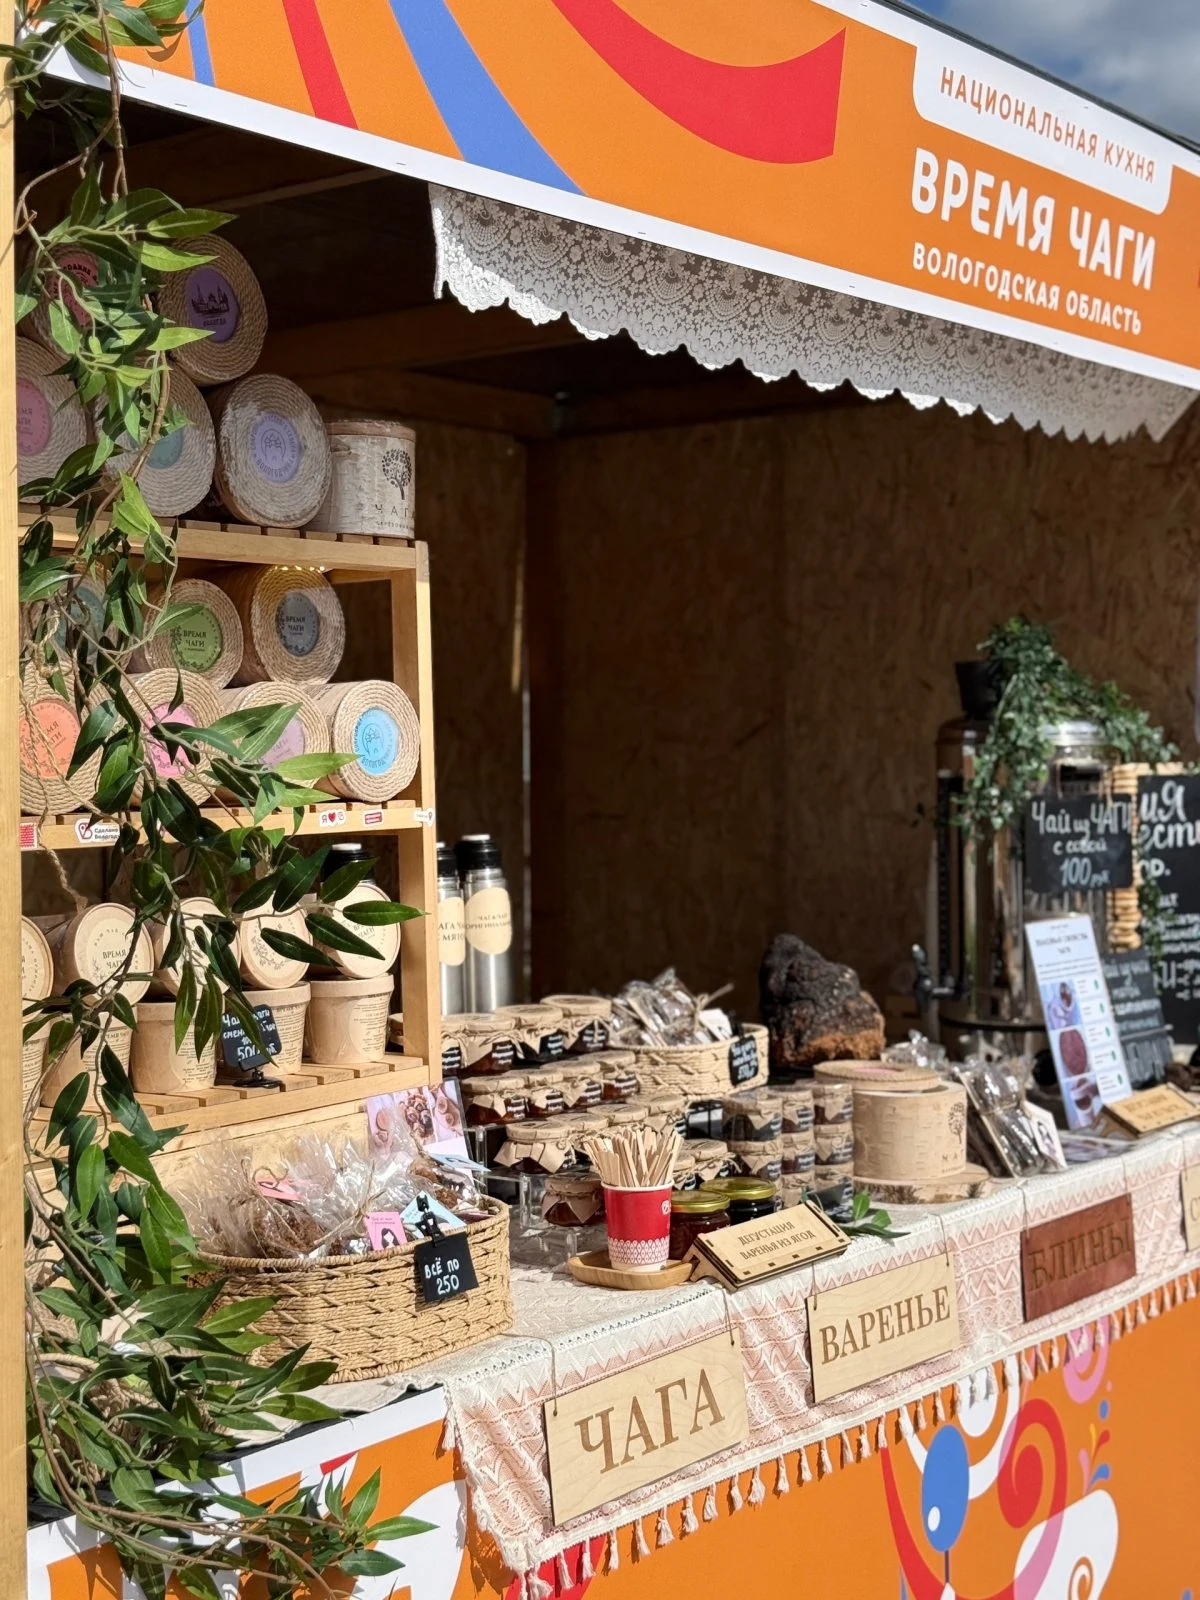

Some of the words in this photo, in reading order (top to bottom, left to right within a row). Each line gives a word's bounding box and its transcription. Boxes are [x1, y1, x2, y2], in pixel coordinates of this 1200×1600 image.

[941, 66, 1098, 158] НАЦИОНАЛЬНАЯ
[1103, 139, 1156, 184] КУХНЯ
[911, 147, 1056, 256] ВРЕМЯ
[1069, 205, 1156, 291] ЧАГИ
[912, 242, 1061, 312] ВОЛОГОДСКАЯ
[1065, 290, 1142, 336] ОБЛАСТЬ
[183, 629, 207, 639] ВРЕМЯ
[285, 615, 306, 623] ВРЕМЯ
[186, 639, 205, 648] ЧАГИ
[94, 826, 119, 834] Сделано
[1031, 801, 1071, 835] Чай
[1059, 856, 1092, 887] 100
[102, 949, 127, 959] ВРЕМЯ
[738, 1221, 795, 1246] ДЕГУСТАЦИЯ
[740, 1239, 780, 1260] ВАРЕНЬЯ
[779, 1237, 792, 1248] ИЗ
[791, 1229, 816, 1244] ЯГОД
[1029, 1218, 1133, 1290] БЛИНЫ
[436, 1274, 460, 1295] 250
[819, 1285, 951, 1366] ВАРЕНЬЕ
[574, 1368, 726, 1474] ЧАГА
